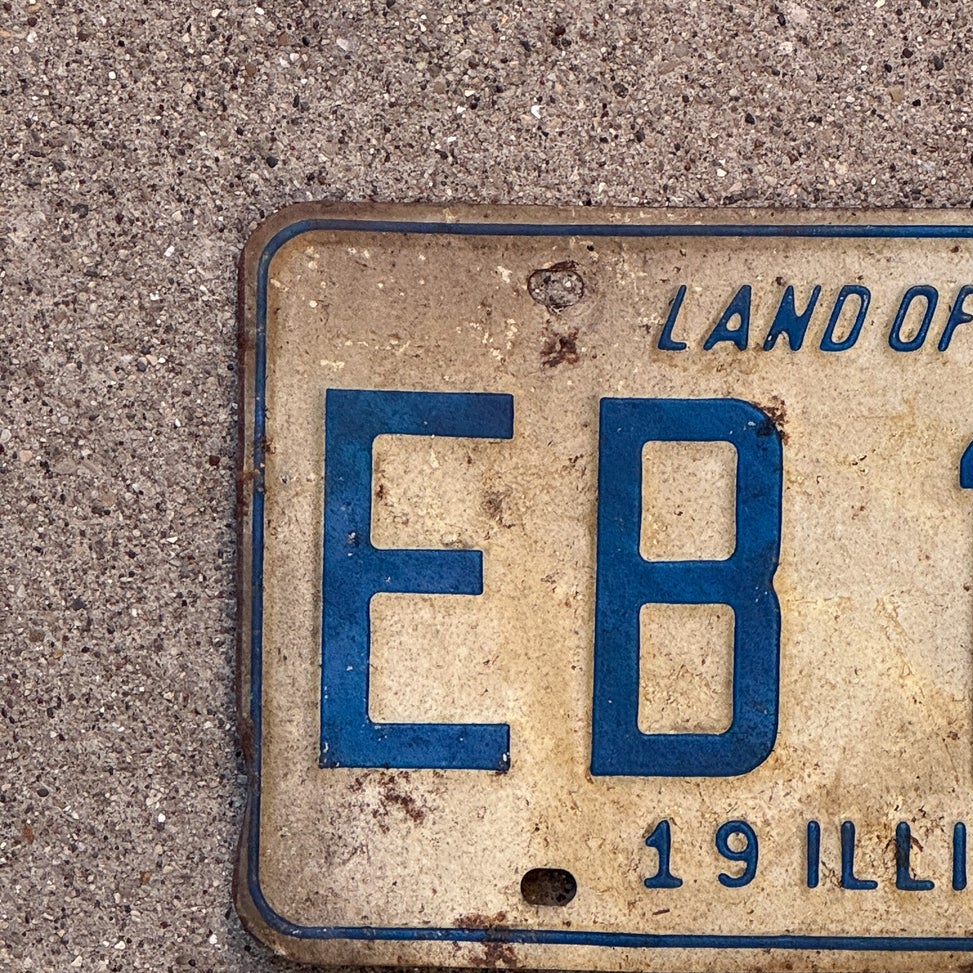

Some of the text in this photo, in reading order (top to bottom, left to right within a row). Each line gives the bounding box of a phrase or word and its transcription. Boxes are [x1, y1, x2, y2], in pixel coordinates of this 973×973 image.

[657, 285, 872, 353] LAND
[319, 387, 784, 778] EB
[644, 820, 759, 889] 19
